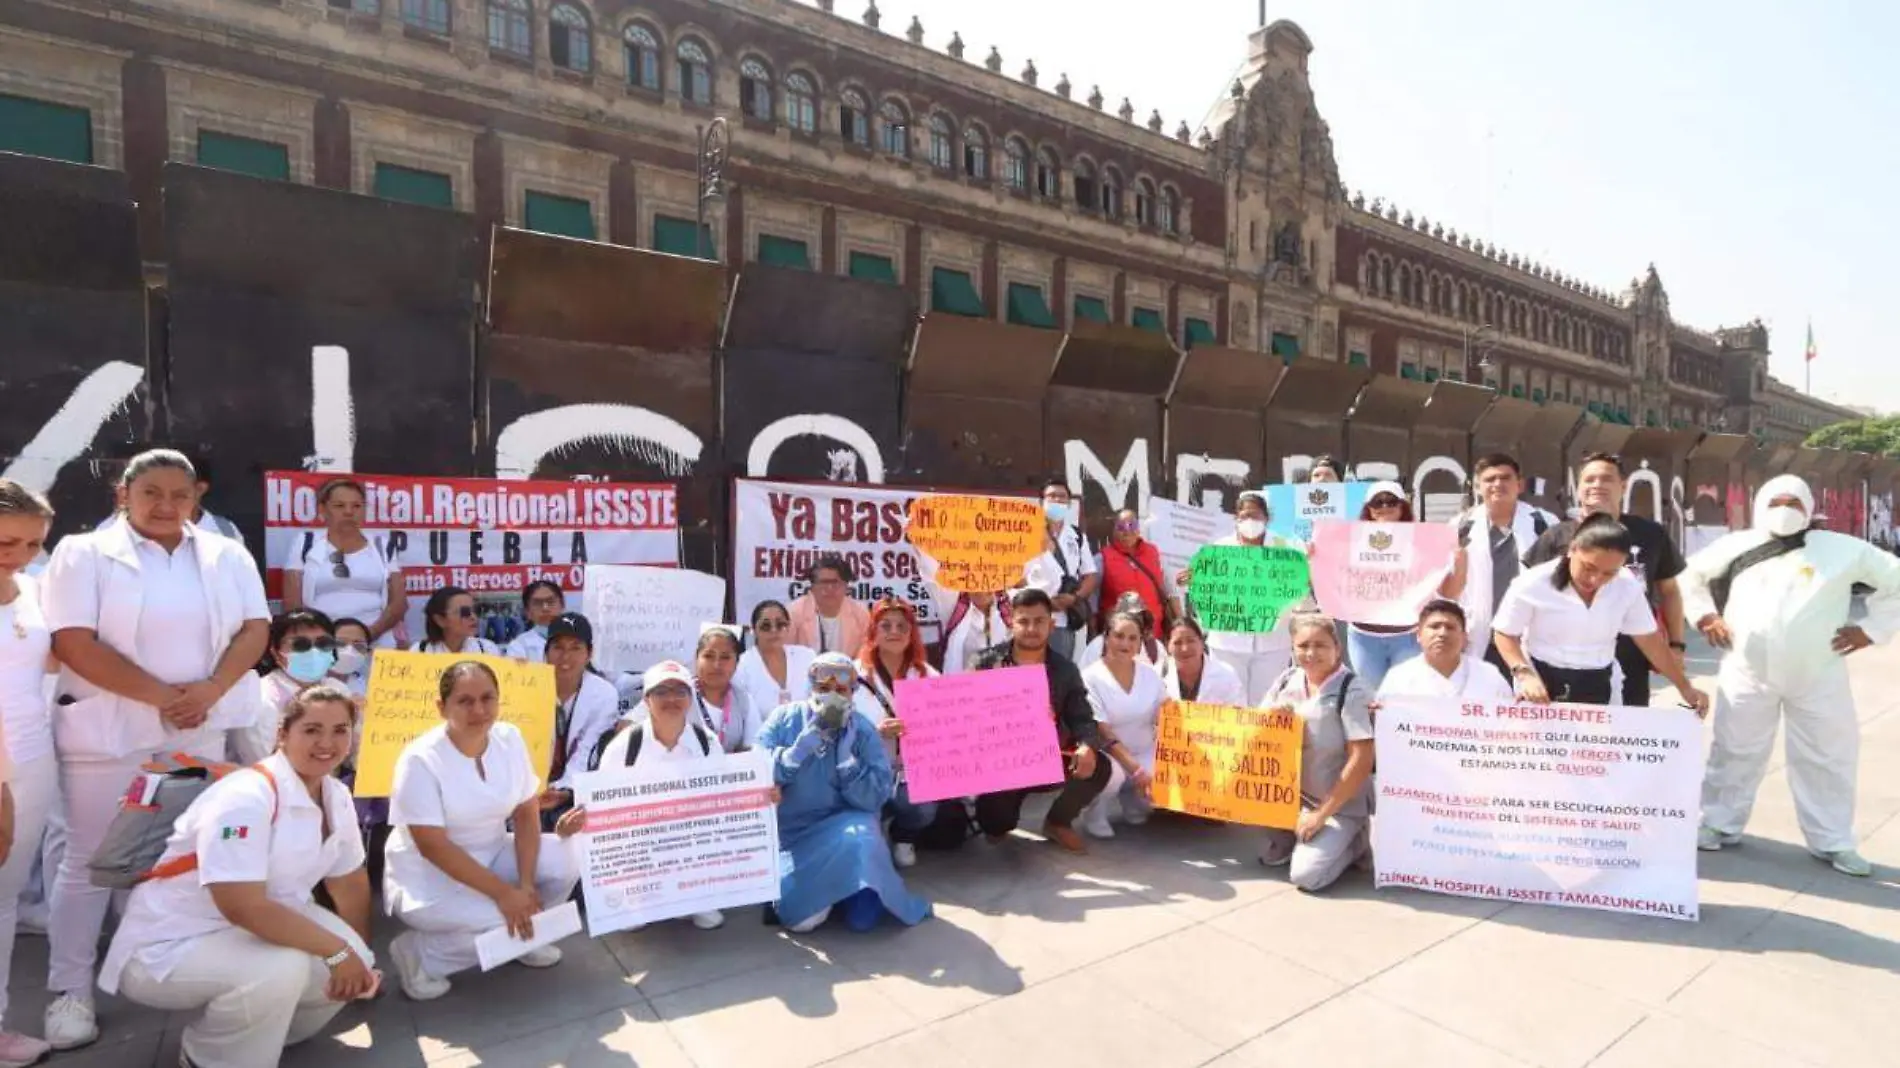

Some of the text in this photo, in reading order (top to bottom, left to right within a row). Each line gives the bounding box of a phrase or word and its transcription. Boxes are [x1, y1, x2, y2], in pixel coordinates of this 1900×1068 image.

[266, 478, 676, 529] Hoital.Regional.ISSSTE
[768, 492, 914, 543] Ya Bas
[754, 545, 874, 581] Exigos
[452, 568, 522, 589] Heroes
[1461, 704, 1612, 724] SR. PRESIDENTE:
[1396, 722, 1411, 733] AL
[1415, 724, 1479, 739] PERSONAL
[1545, 732, 1571, 743] QUE
[1575, 734, 1658, 748] LABORAMOS
[1662, 739, 1679, 749] EN
[1409, 738, 1477, 753] PANDEMIA
[1482, 745, 1495, 755] SE
[1497, 745, 1522, 756] NOS
[1571, 749, 1621, 763] HEROES
[1625, 752, 1632, 761] Y
[1637, 753, 1666, 764] HOY
[1460, 758, 1517, 770] ESTAMOS
[1520, 760, 1536, 770] EN
[1540, 762, 1552, 772] EL
[591, 769, 756, 803] HOSPITAL REGIONAL ISSSTE PUEBLA
[1235, 779, 1295, 805] OLVIDO
[1382, 785, 1686, 819] ALZAMOS LA VOZ PARA SER ESCUCHADOS DE LAS
[1421, 805, 1642, 831] INJUSTICIAS DEL SISTEMA DE SALUD
[1379, 869, 1429, 886] CLÍNICA
[1434, 877, 1502, 897] HOSPITAL
[1508, 888, 1555, 901] ISSSTE
